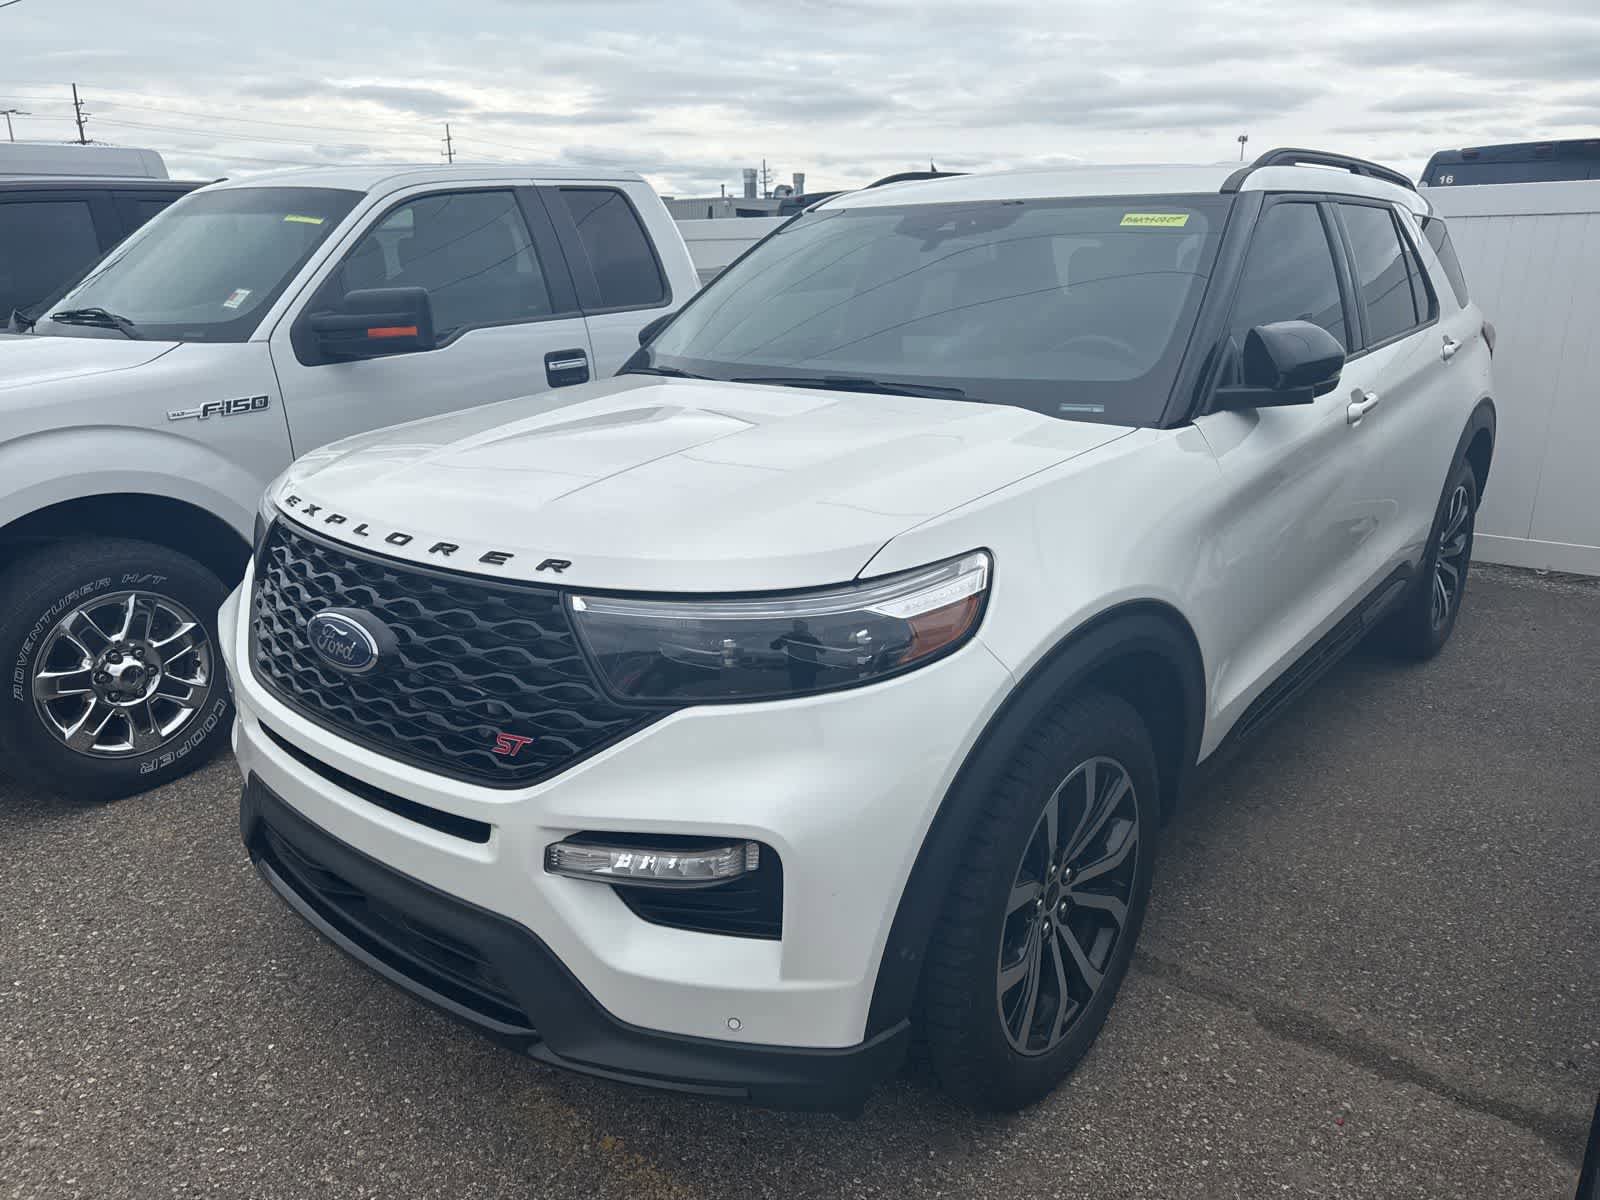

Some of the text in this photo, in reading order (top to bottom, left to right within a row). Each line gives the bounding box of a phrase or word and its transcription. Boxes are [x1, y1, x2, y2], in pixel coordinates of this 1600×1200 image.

[1440, 175, 1454, 185] 16
[201, 395, 269, 418] F-150
[285, 495, 573, 573] EXPLORER
[13, 577, 112, 701] ADVENTURER
[317, 623, 357, 661] Ford
[140, 699, 227, 774] COOPER
[491, 733, 534, 756] ST
